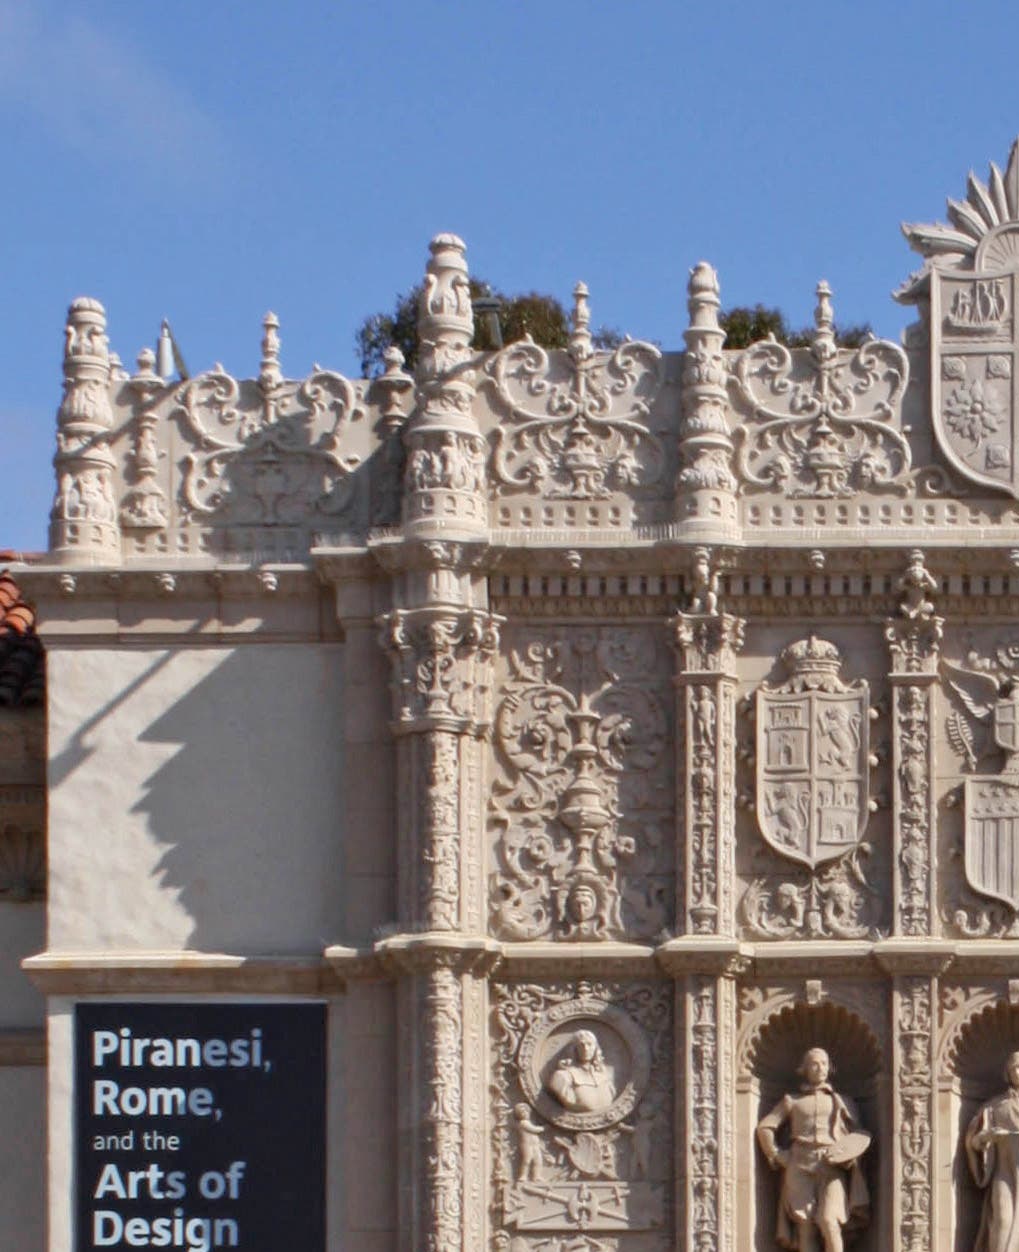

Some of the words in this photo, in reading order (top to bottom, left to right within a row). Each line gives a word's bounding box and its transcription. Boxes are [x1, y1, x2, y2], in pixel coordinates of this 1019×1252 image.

[94, 1027, 271, 1072] Piranesi,
[94, 1080, 222, 1120] Rome,
[94, 1130, 134, 1150] and
[143, 1131, 180, 1150] the
[94, 1163, 186, 1199] Arts
[200, 1161, 246, 1199] of
